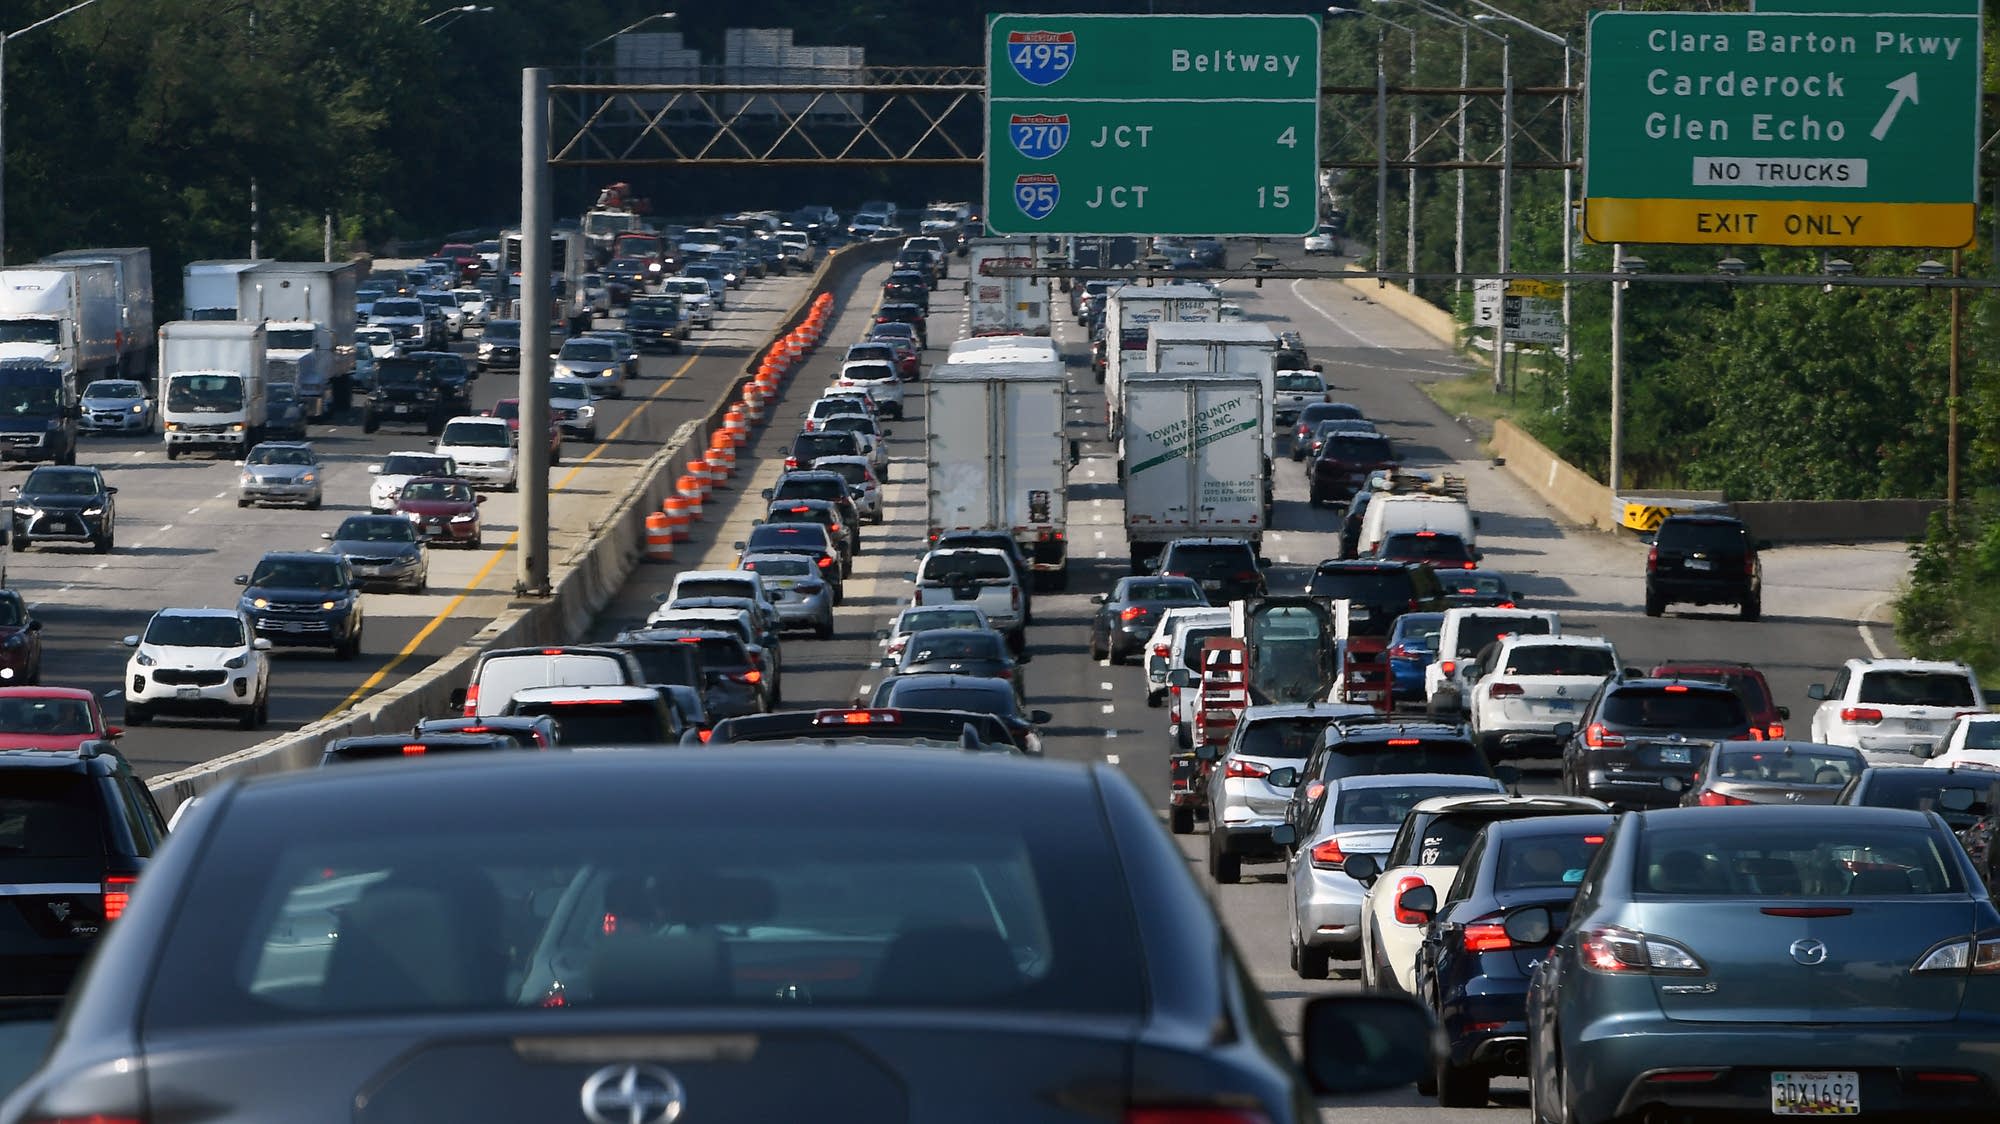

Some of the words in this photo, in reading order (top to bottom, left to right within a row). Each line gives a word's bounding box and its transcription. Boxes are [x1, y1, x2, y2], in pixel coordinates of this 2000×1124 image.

[1648, 29, 1729, 52] Clara
[1747, 30, 1856, 53] Barton
[1876, 32, 1960, 60] Pkwy
[1014, 45, 1070, 70] 495
[1172, 49, 1300, 77] Beltway
[1647, 68, 1845, 96] Carderock
[1019, 126, 1062, 150] 270
[1091, 126, 1153, 148] JCT
[1277, 127, 1297, 149] 4
[1645, 112, 1729, 140] Glen
[1752, 114, 1845, 141] Echo
[1709, 163, 1740, 181] NO
[1755, 163, 1850, 181] TRUCKS
[1020, 186, 1054, 211] 95
[1086, 186, 1149, 208] JCT
[1257, 186, 1290, 208] 15
[1697, 213, 1758, 233] EXIT
[1784, 214, 1862, 235] ONLY
[1214, 413, 1235, 427] INC.
[1146, 422, 1179, 442] TOWN
[1777, 1084, 1854, 1106] 3DX1692
